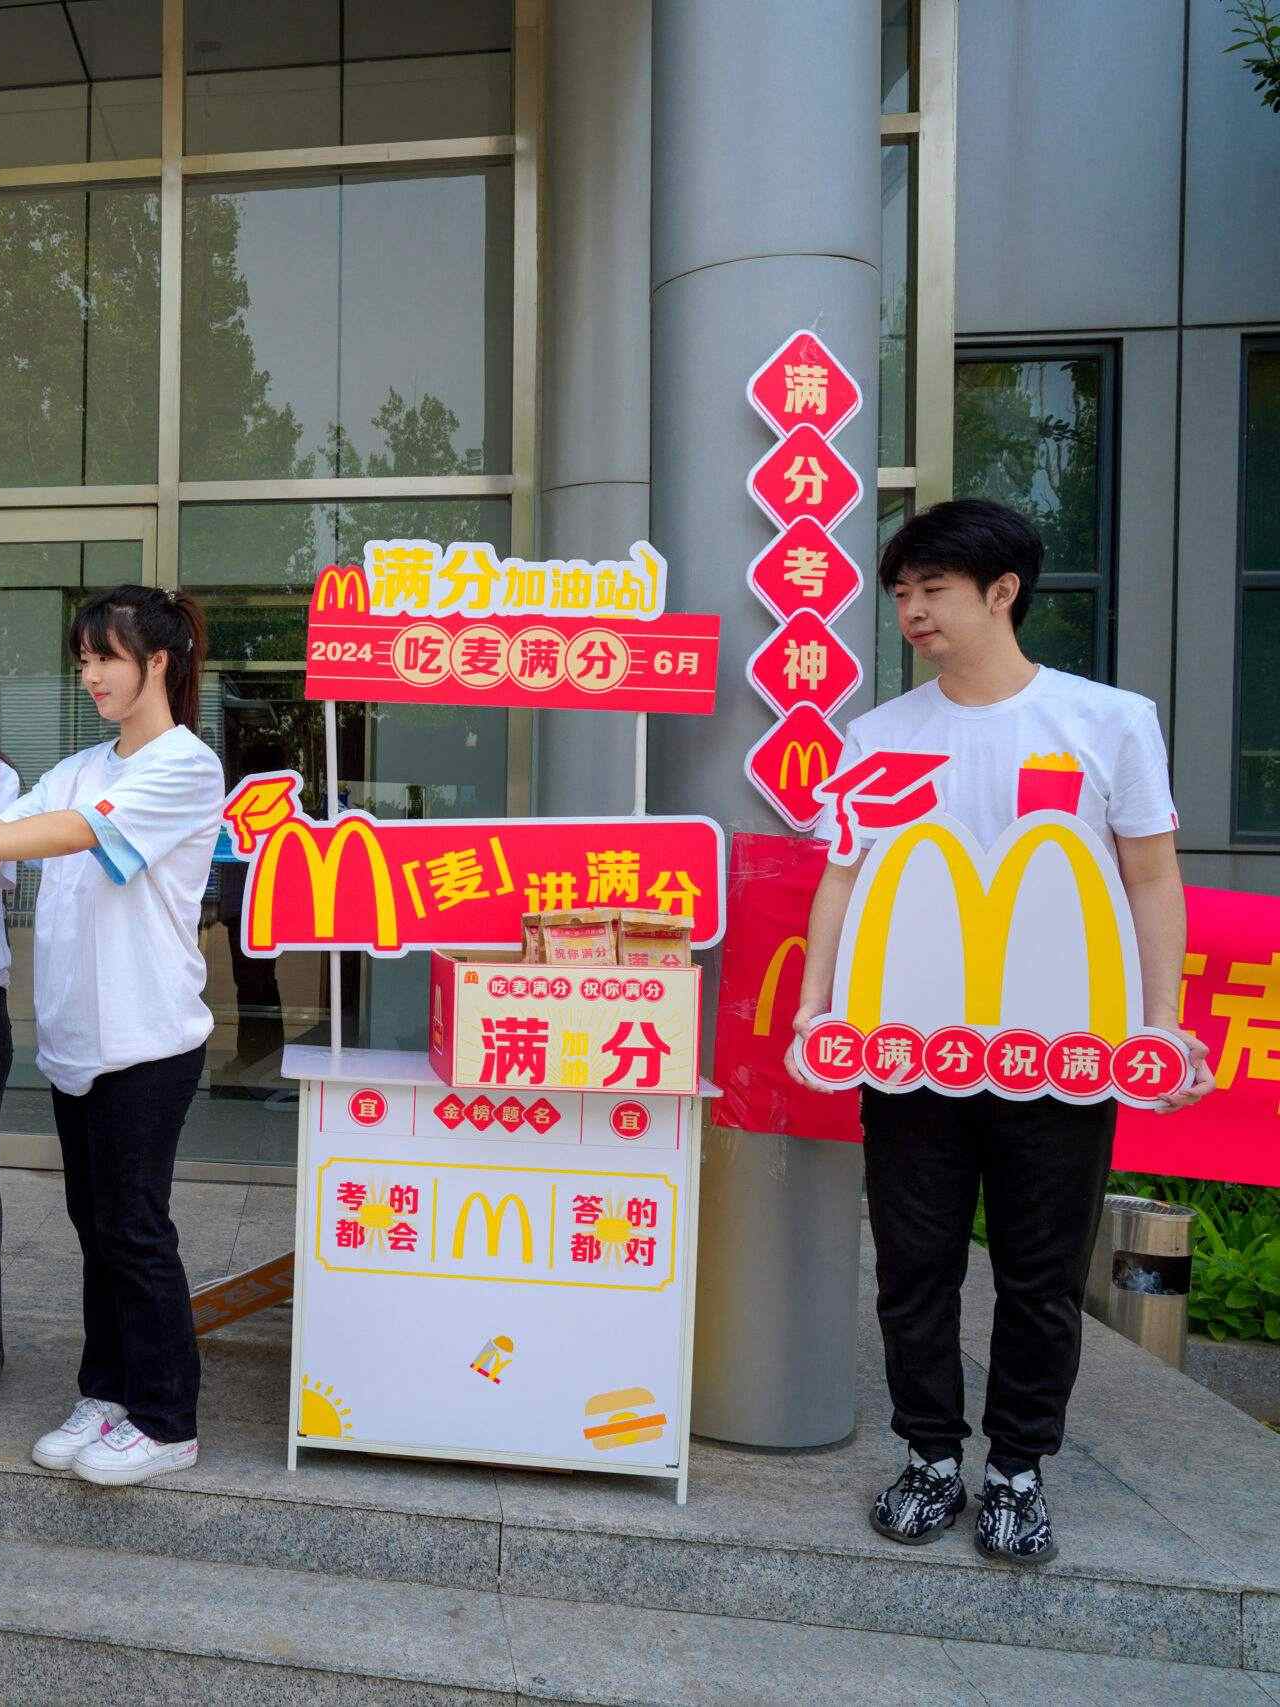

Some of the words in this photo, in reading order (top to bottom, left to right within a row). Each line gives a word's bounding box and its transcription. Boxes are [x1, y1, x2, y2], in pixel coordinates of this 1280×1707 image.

[783, 364, 829, 690] 满分考神
[371, 548, 646, 611] 满分加油站
[311, 640, 373, 663] 2024
[404, 635, 618, 680] 吃麦满分
[654, 650, 700, 676] 6月
[491, 980, 569, 996] 吃麦满分
[584, 981, 661, 998] 祝你满分
[818, 1035, 1167, 1086] 吃满分祝满分
[442, 1103, 551, 1125] 金榜题名
